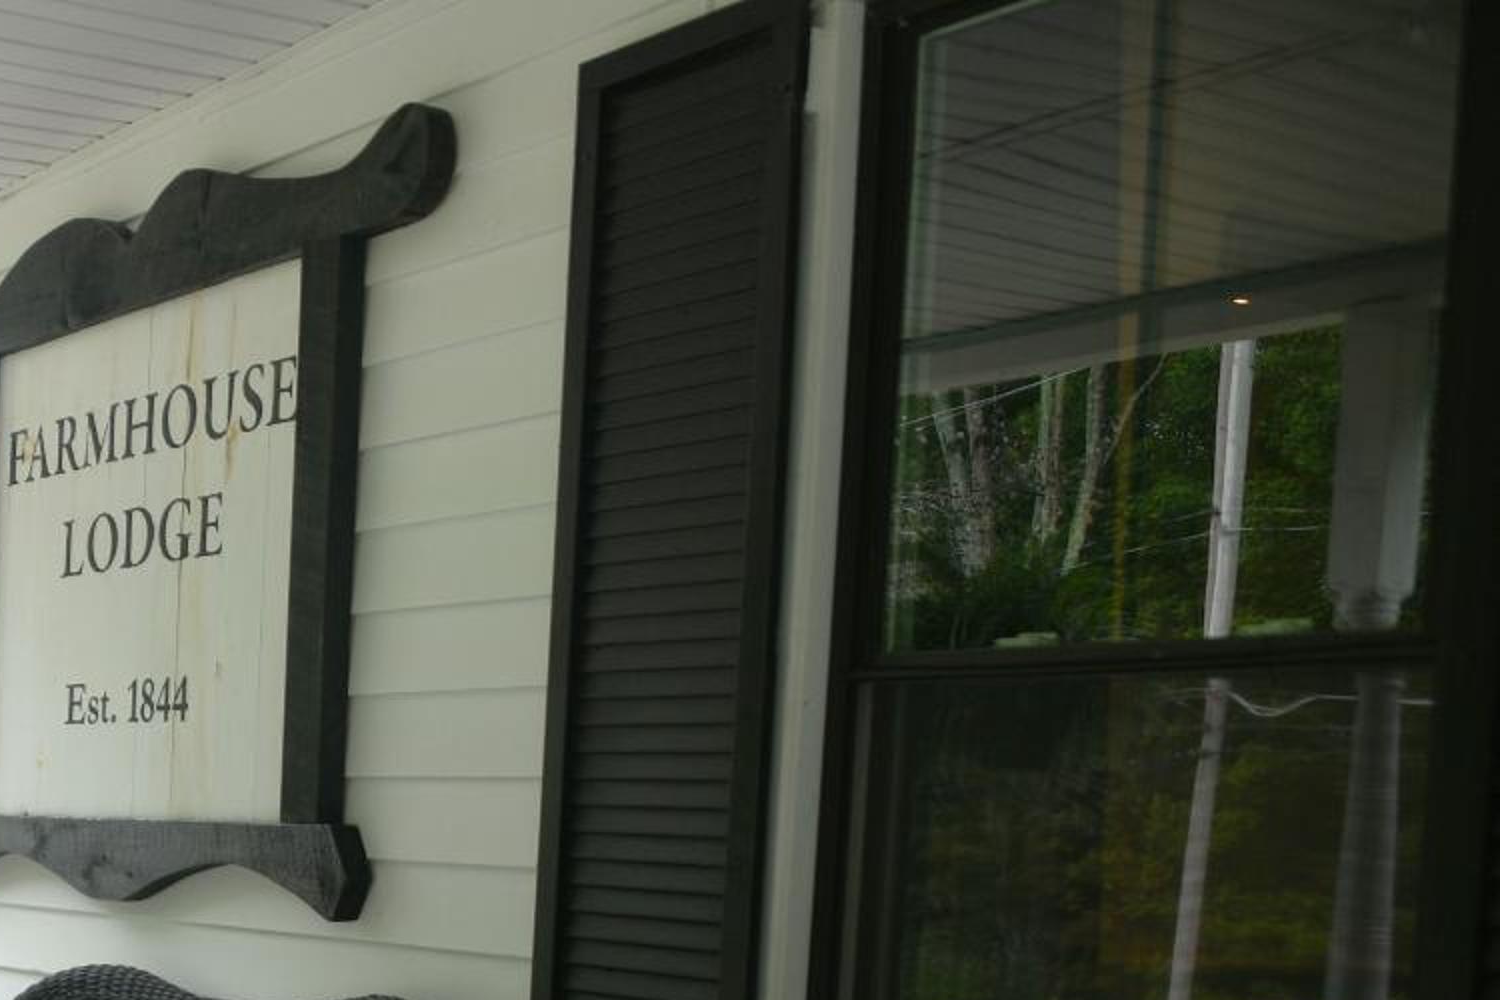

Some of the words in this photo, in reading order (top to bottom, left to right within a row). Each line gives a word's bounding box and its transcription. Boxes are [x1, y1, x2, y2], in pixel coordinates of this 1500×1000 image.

[8, 355, 297, 486] FARMHOUSE
[61, 492, 224, 578] LODGE
[65, 683, 116, 725] Est.
[127, 675, 189, 723] 1844
